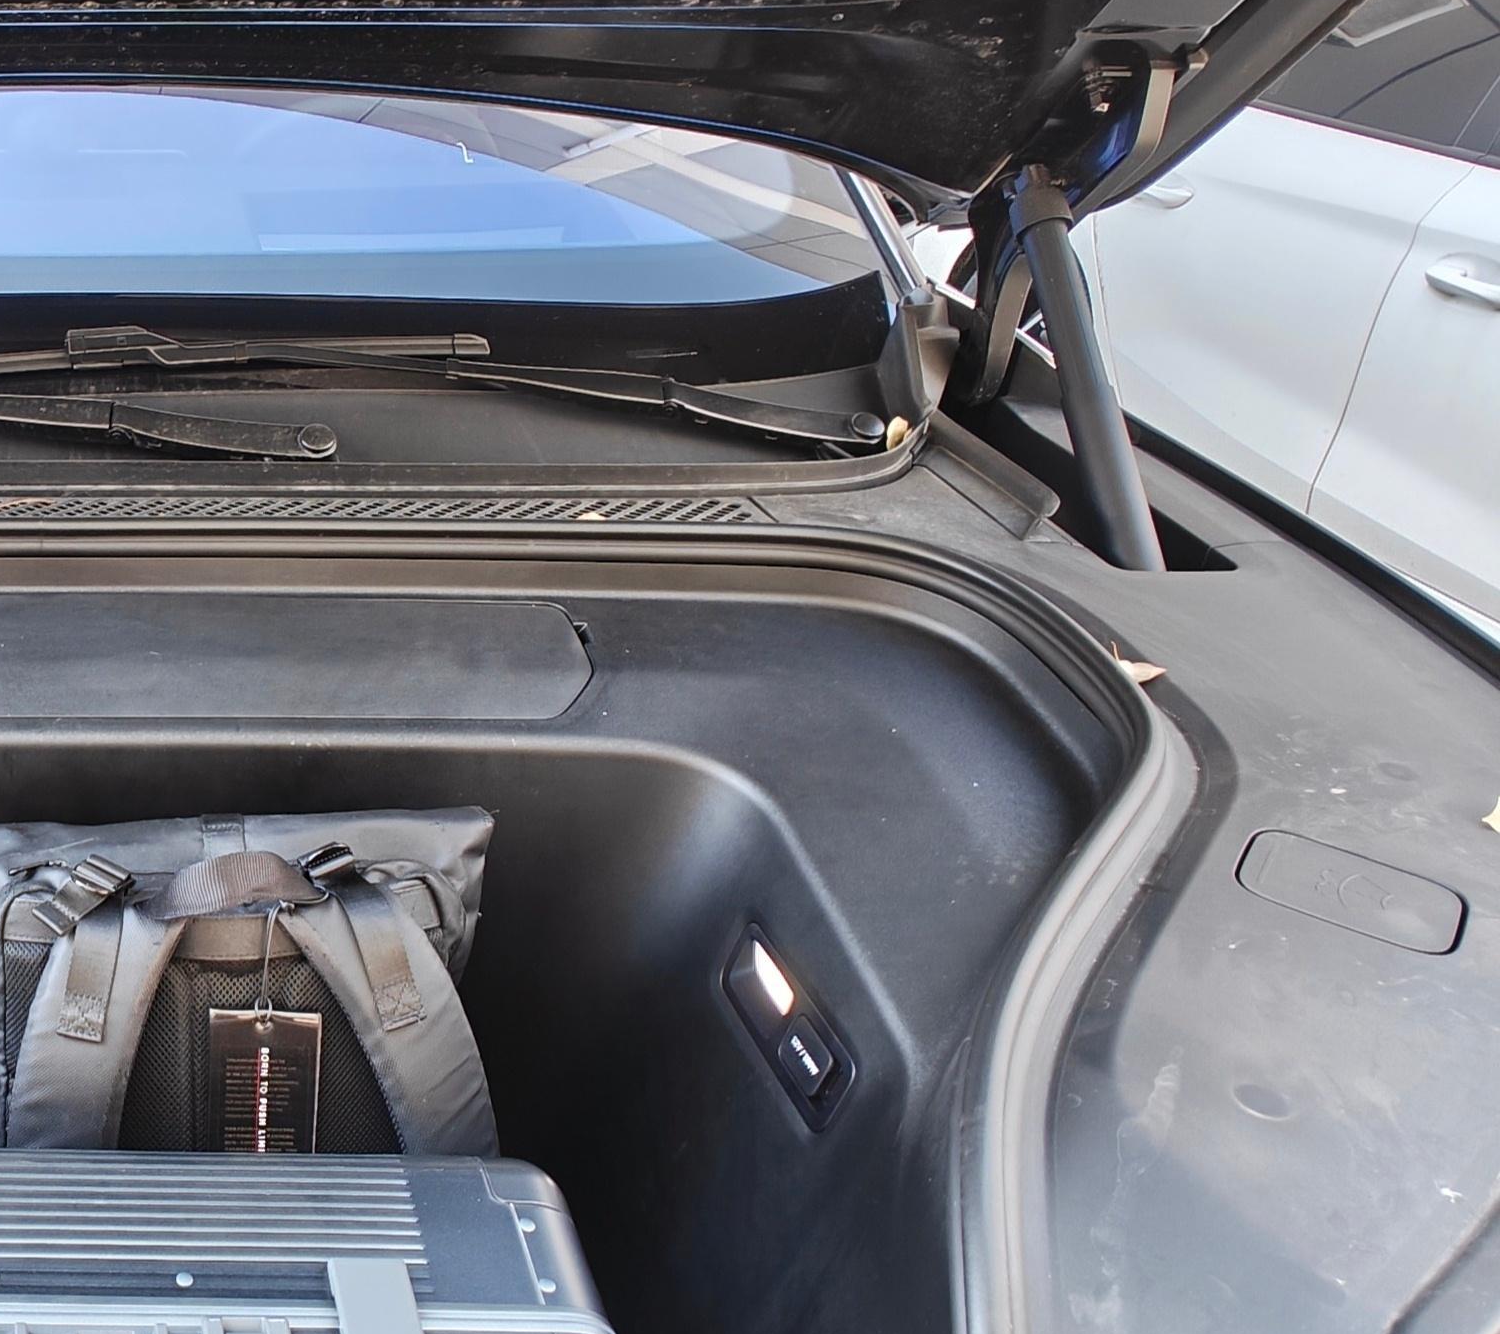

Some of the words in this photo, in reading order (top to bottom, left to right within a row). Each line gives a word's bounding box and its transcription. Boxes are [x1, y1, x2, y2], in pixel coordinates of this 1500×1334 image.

[260, 1047, 269, 1076] BORN
[260, 1081, 268, 1094] TO
[258, 1097, 267, 1125] PUSH
